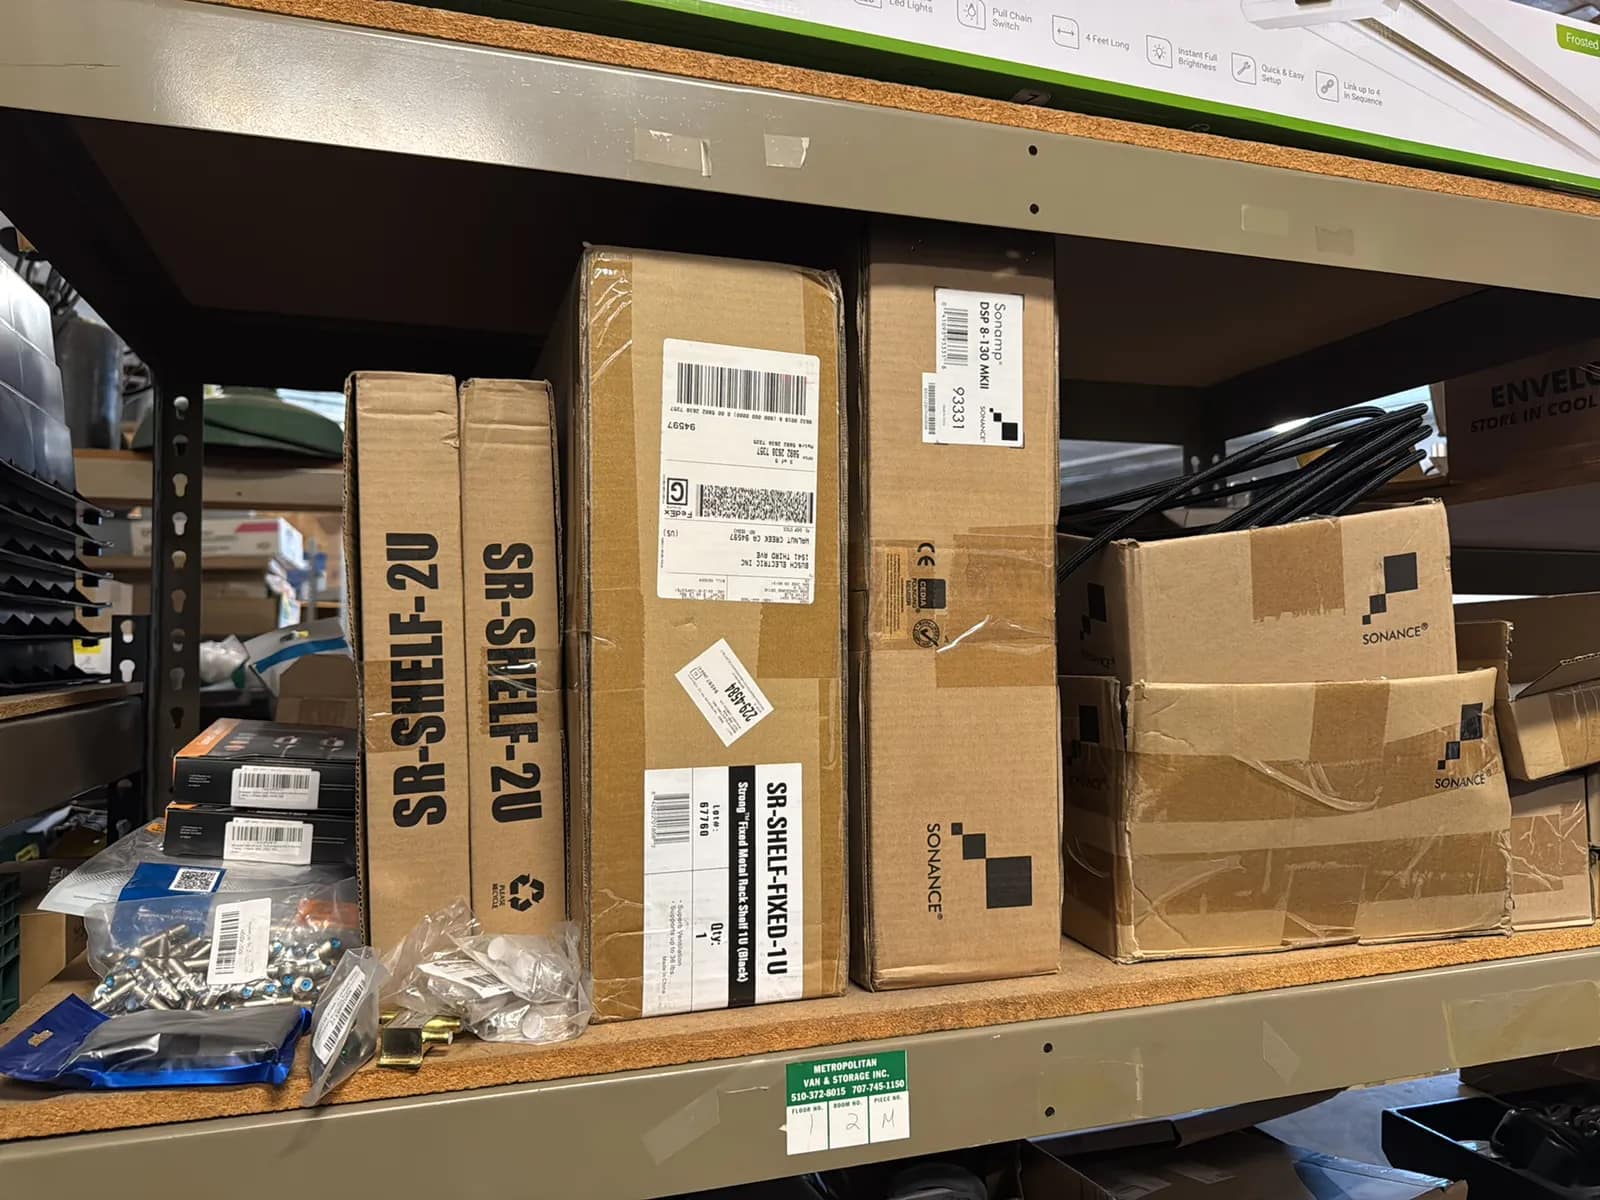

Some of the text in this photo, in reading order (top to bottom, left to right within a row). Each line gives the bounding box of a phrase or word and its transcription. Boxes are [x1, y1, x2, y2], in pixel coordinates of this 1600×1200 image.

[908, 0, 933, 12] Lights
[992, 8, 1033, 24] Pull Chain
[992, 18, 1020, 30] Switch
[1092, 35, 1109, 46] Feet
[1110, 39, 1130, 50] Long
[1566, 32, 1599, 50] Frosted
[1178, 48, 1218, 62] Instant Full
[1178, 57, 1216, 71] Brightness
[1262, 64, 1280, 74] Quick
[1290, 70, 1304, 80] Easy
[1262, 74, 1282, 86] Setup
[1344, 82, 1357, 90] Link
[1358, 86, 1368, 94] up
[1352, 93, 1383, 106] Sequence
[980, 302, 990, 390] DSP 8-130 MKII
[952, 386, 965, 429] 93331
[1470, 395, 1598, 432] STORE IN COOL
[667, 421, 696, 431] 94597
[670, 482, 684, 502] G
[664, 509, 693, 518] FedEx
[764, 536, 784, 544] CREEK
[787, 536, 810, 544] WALNUT
[740, 559, 752, 567] INC
[756, 560, 787, 568] ELECTRIC
[771, 552, 790, 560] THIRD
[386, 532, 447, 828] SR-SHELF-2U
[483, 542, 542, 824] SR-SHELF-2U
[700, 802, 709, 837] 67760
[738, 822, 748, 846] Fixed
[738, 848, 748, 876] Metal
[767, 782, 788, 975] SR-SHELF-FIXED-1U
[738, 878, 748, 903] Rack
[738, 904, 748, 930] Shelf
[710, 922, 724, 946] Qty:
[738, 931, 748, 945] 1U
[736, 947, 748, 982] (Black)
[814, 1058, 877, 1074] METROPOLITAN
[804, 1069, 890, 1088] VAN & STORAGE INC.
[791, 1080, 904, 1102] 510-372-8015 707-745-1150
[874, 1096, 890, 1104] PIECE
[792, 1106, 811, 1115] FLOOR
[846, 1112, 860, 1130] 2
